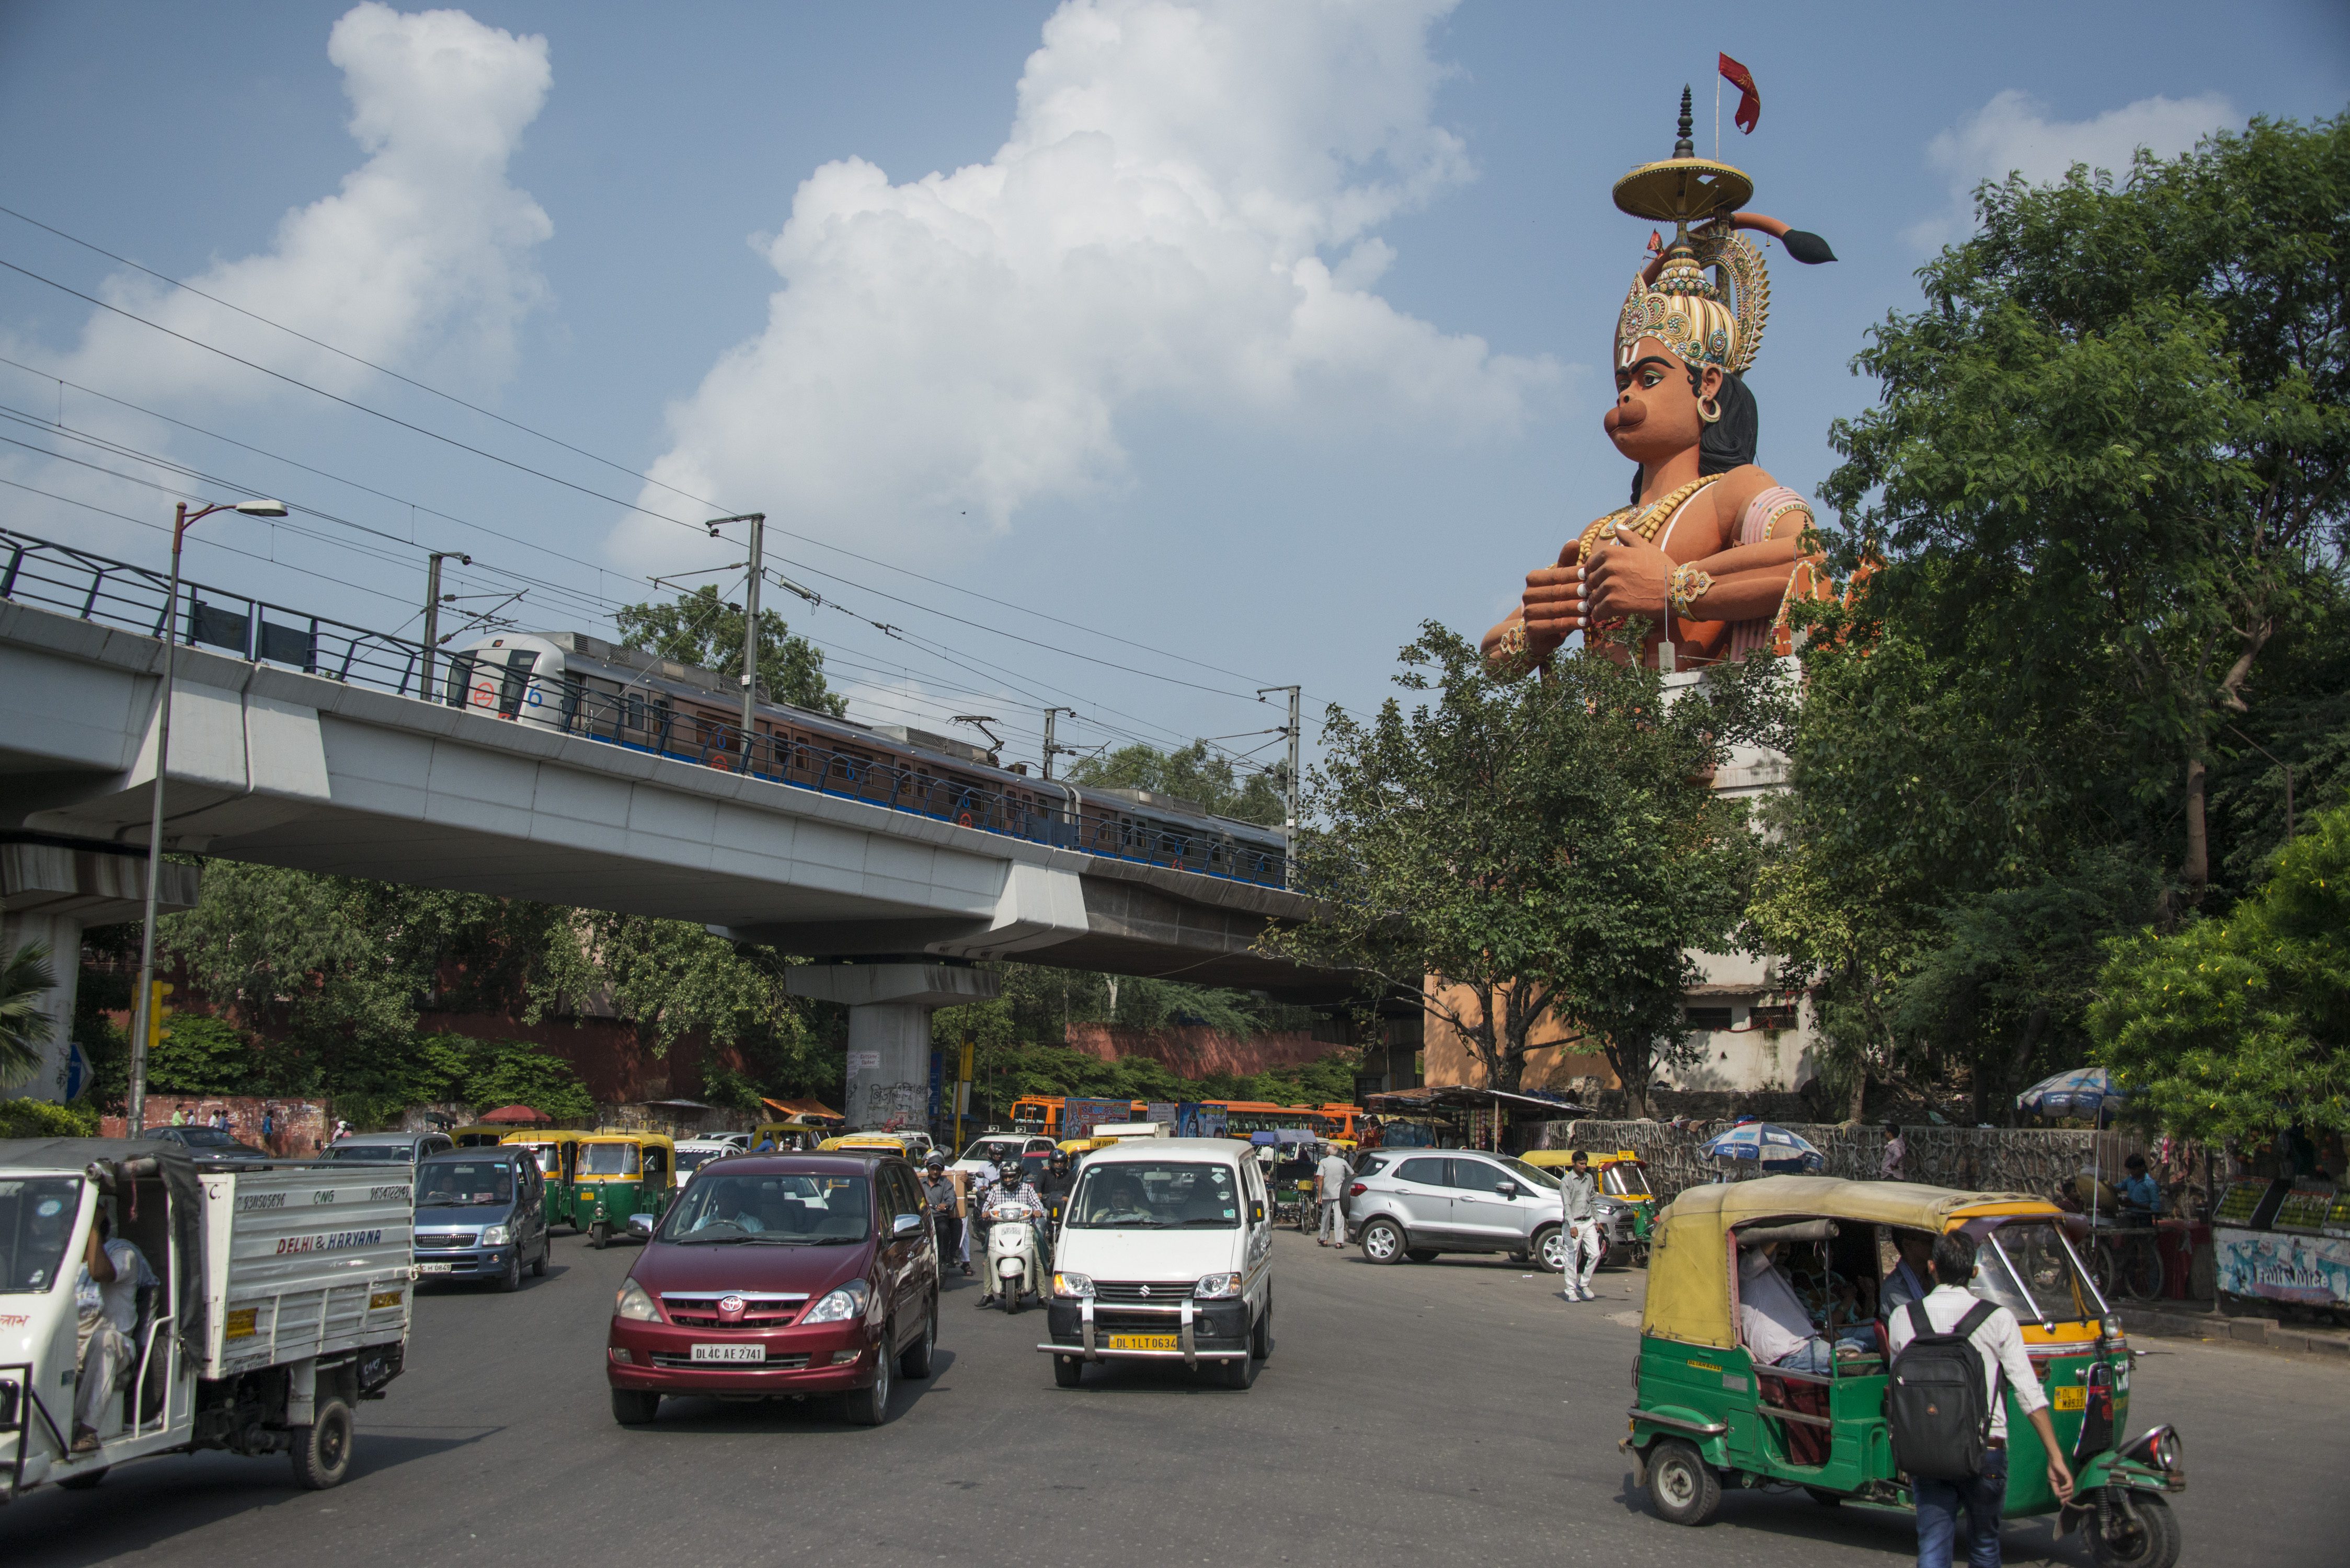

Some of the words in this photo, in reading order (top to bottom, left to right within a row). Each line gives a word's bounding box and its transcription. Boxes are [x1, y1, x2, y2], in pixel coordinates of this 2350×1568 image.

[528, 684, 543, 708] 6
[717, 728, 726, 749] 6
[314, 1190, 335, 1204] CNG
[277, 1238, 313, 1254] DELHI
[316, 1236, 324, 1249] &
[327, 1229, 381, 1250] HARYANA
[2254, 1262, 2283, 1284] Fruit
[2283, 1265, 2329, 1288] Juice
[1117, 1338, 1128, 1347] DL
[696, 1348, 720, 1359] DL4C
[724, 1348, 736, 1359] AE
[739, 1348, 761, 1359] 2741
[2062, 1389, 2071, 1398] DL
